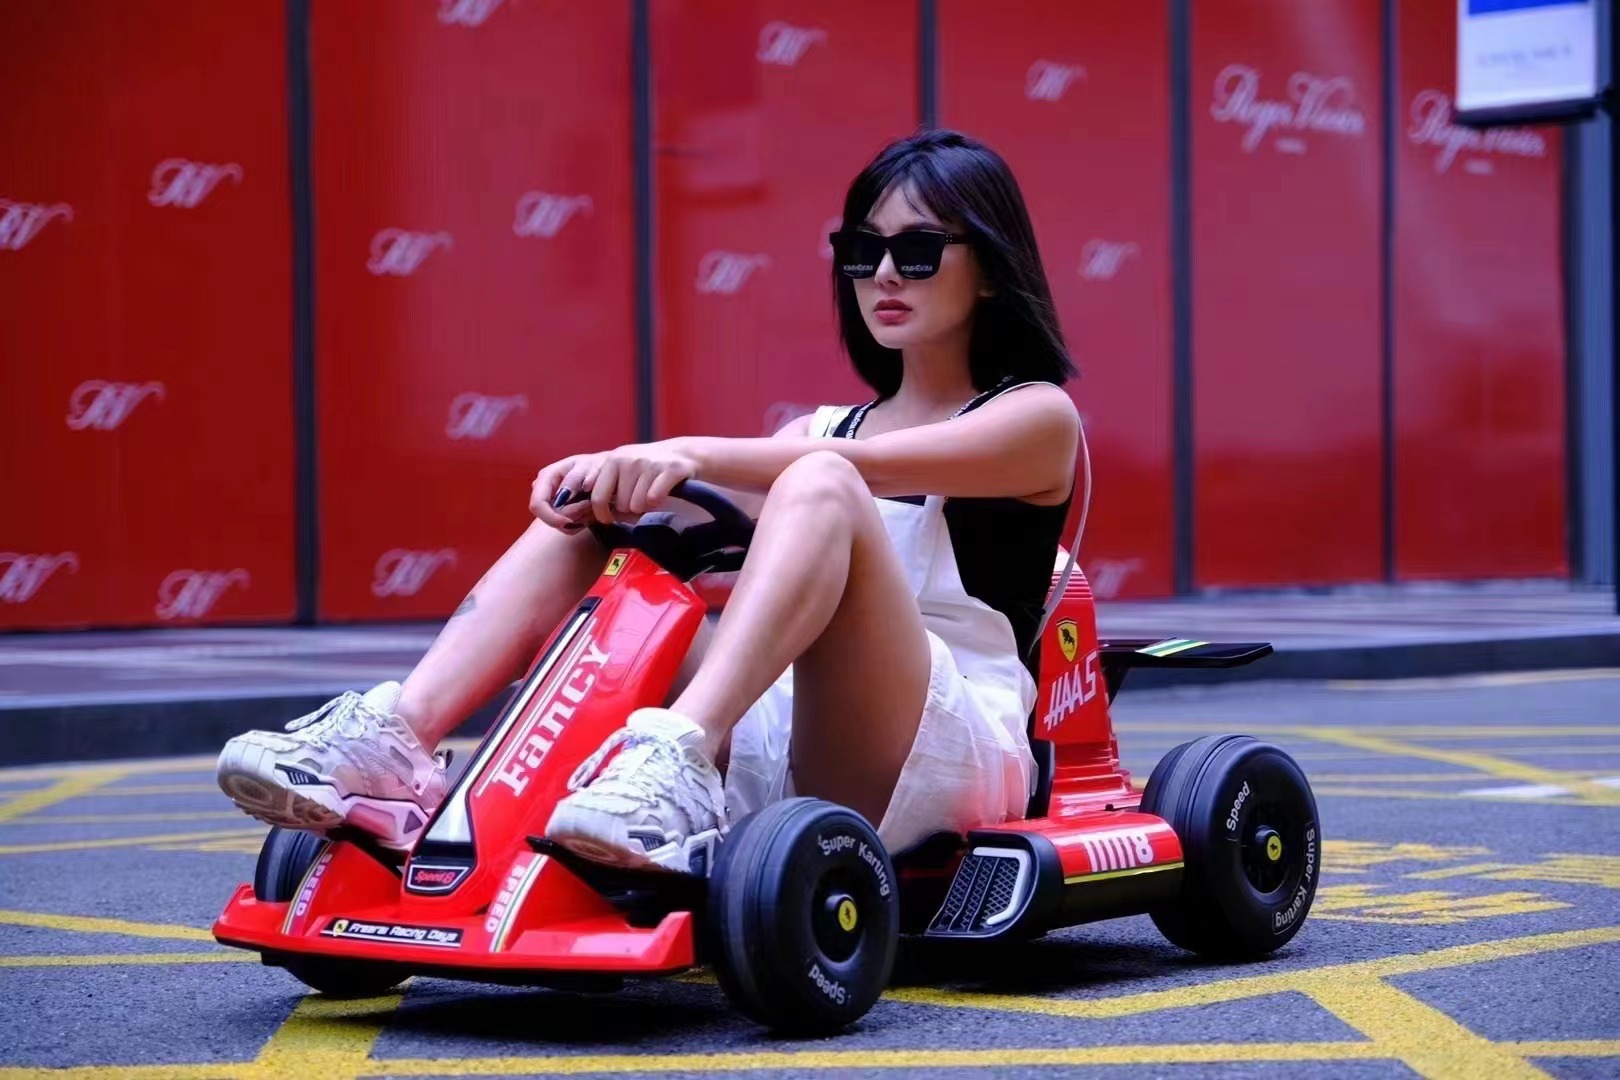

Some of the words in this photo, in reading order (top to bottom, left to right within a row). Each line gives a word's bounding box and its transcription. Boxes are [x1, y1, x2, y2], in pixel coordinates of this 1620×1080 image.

[1226, 781, 1250, 831] Speed
[821, 836, 856, 856] Super
[858, 842, 890, 897] Karting
[1306, 828, 1316, 883] Super
[296, 853, 333, 917] SPEED
[484, 865, 527, 933] SPEED
[1275, 885, 1307, 927] Karting
[389, 926, 428, 940] Racing
[427, 930, 458, 942] Days
[808, 963, 846, 1004] Speed
